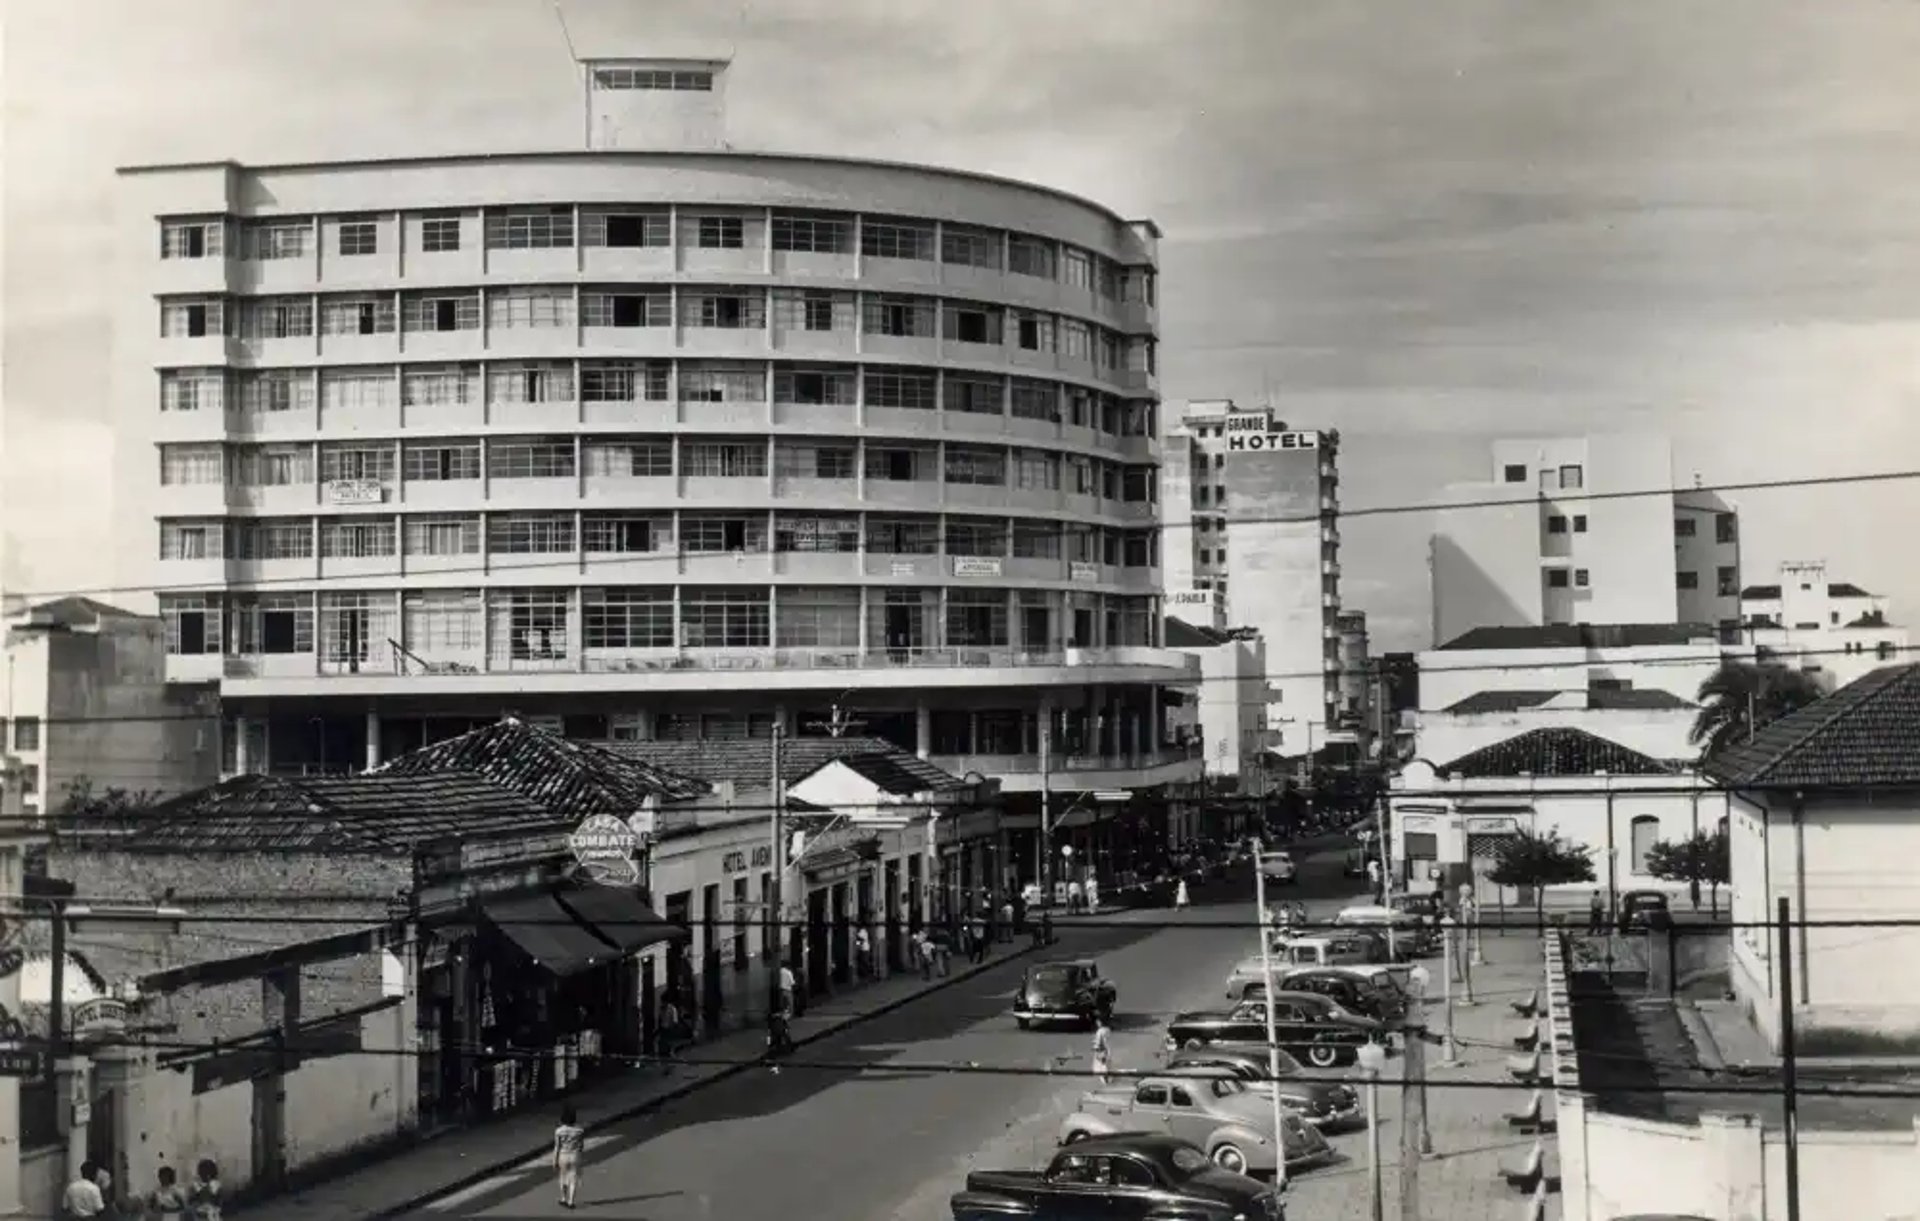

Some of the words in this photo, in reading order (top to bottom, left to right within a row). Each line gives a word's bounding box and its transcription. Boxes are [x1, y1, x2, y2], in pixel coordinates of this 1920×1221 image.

[1228, 417, 1265, 431] GRANDE
[1230, 434, 1314, 450] HOTEL
[570, 834, 636, 848] COMBATE
[722, 851, 747, 874] HOTEL
